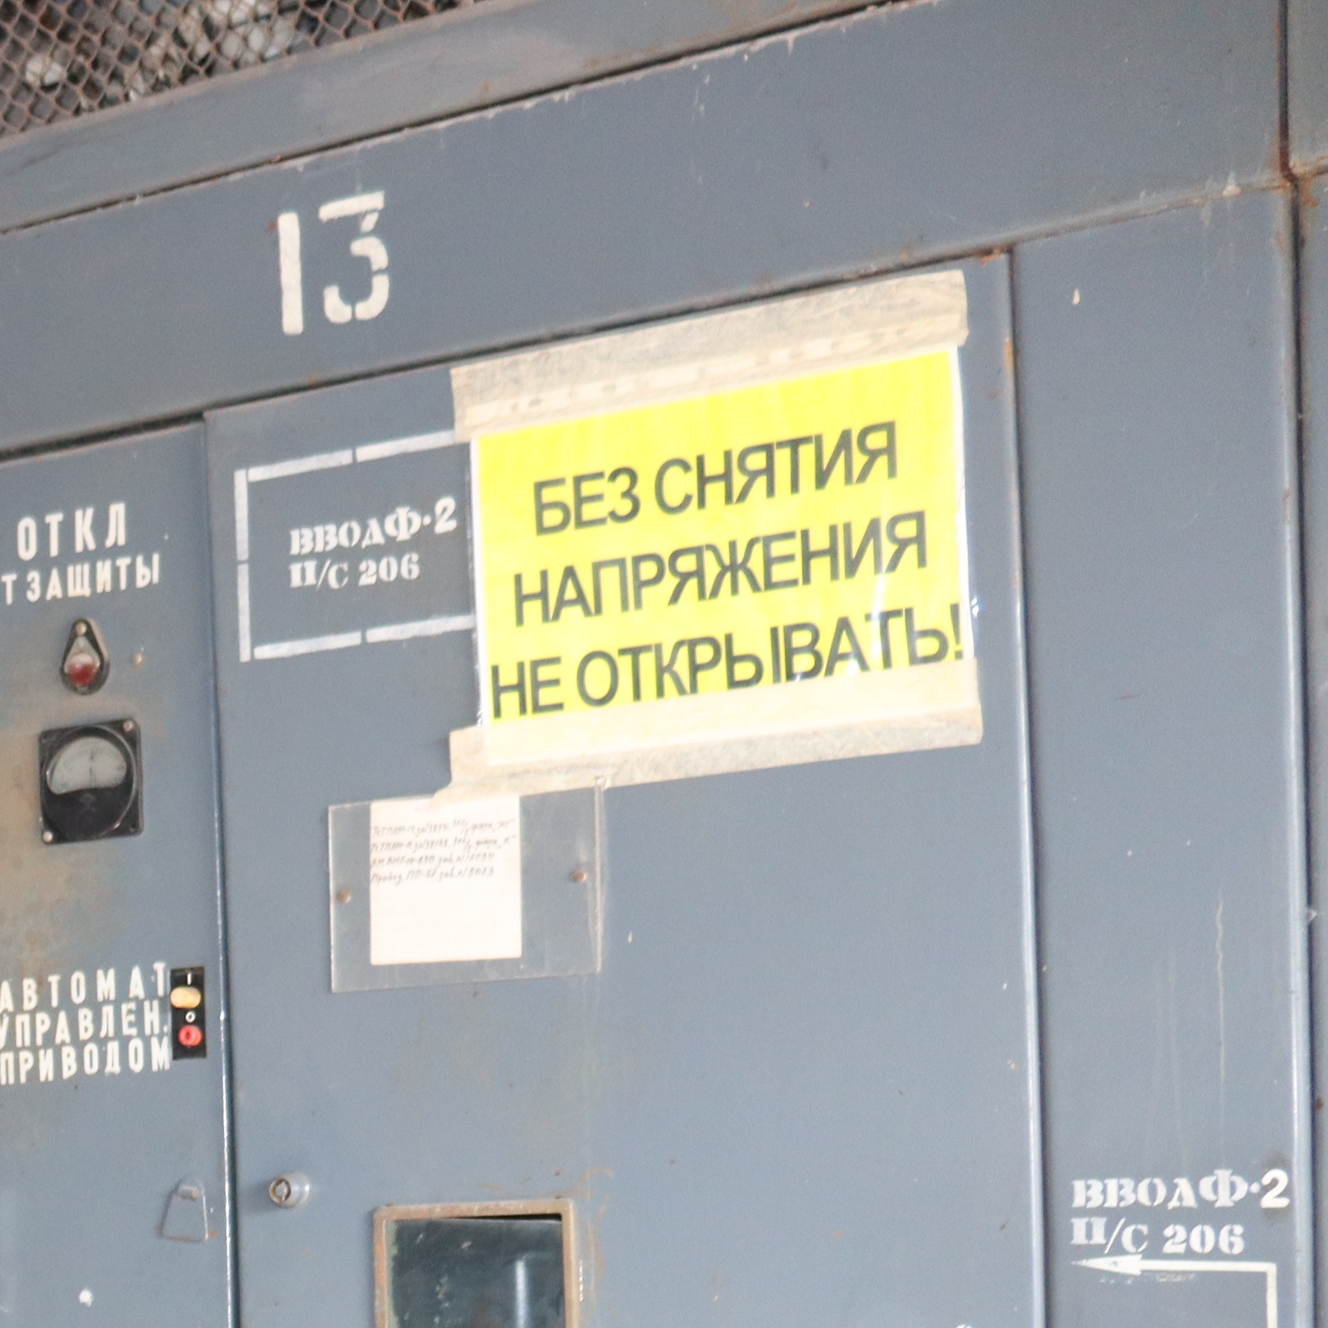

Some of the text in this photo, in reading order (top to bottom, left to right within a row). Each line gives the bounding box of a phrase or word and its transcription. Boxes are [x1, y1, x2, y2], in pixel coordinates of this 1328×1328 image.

[277, 190, 390, 336] 13
[16, 502, 126, 562] ОТКЛ
[533, 419, 898, 537] БЕЗ СНЯТИЯ
[358, 554, 422, 587] 206
[513, 509, 929, 627] НАПРЯЖЕНИЯ
[490, 602, 965, 719] НЕ ОТКРЫВАТЬ!
[1162, 1224, 1246, 1255] 206
